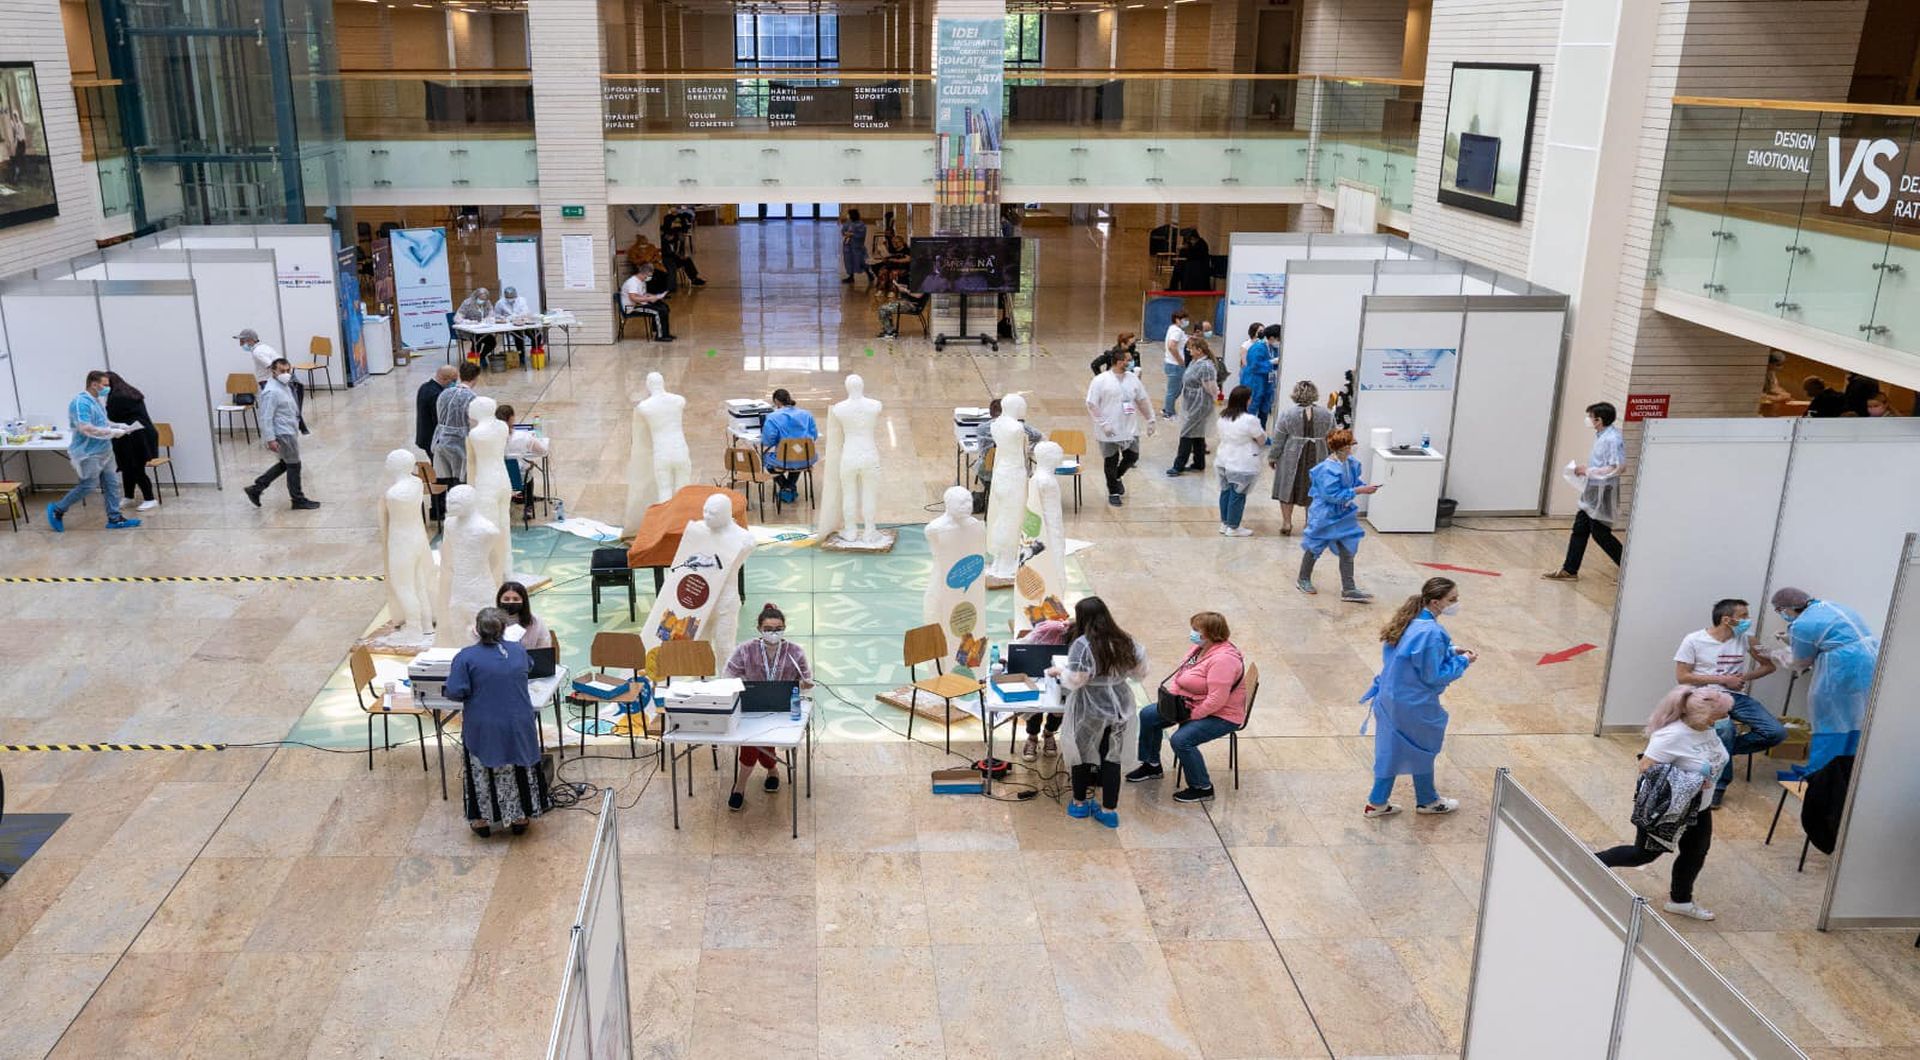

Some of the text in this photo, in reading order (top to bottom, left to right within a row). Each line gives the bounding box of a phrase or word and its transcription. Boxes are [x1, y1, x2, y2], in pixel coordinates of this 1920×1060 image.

[952, 27, 979, 38] IDEI
[1774, 130, 1817, 151] DESIGN
[1828, 136, 1900, 214] VS
[1899, 175, 1920, 193] DE
[1894, 200, 1920, 220] RAT
